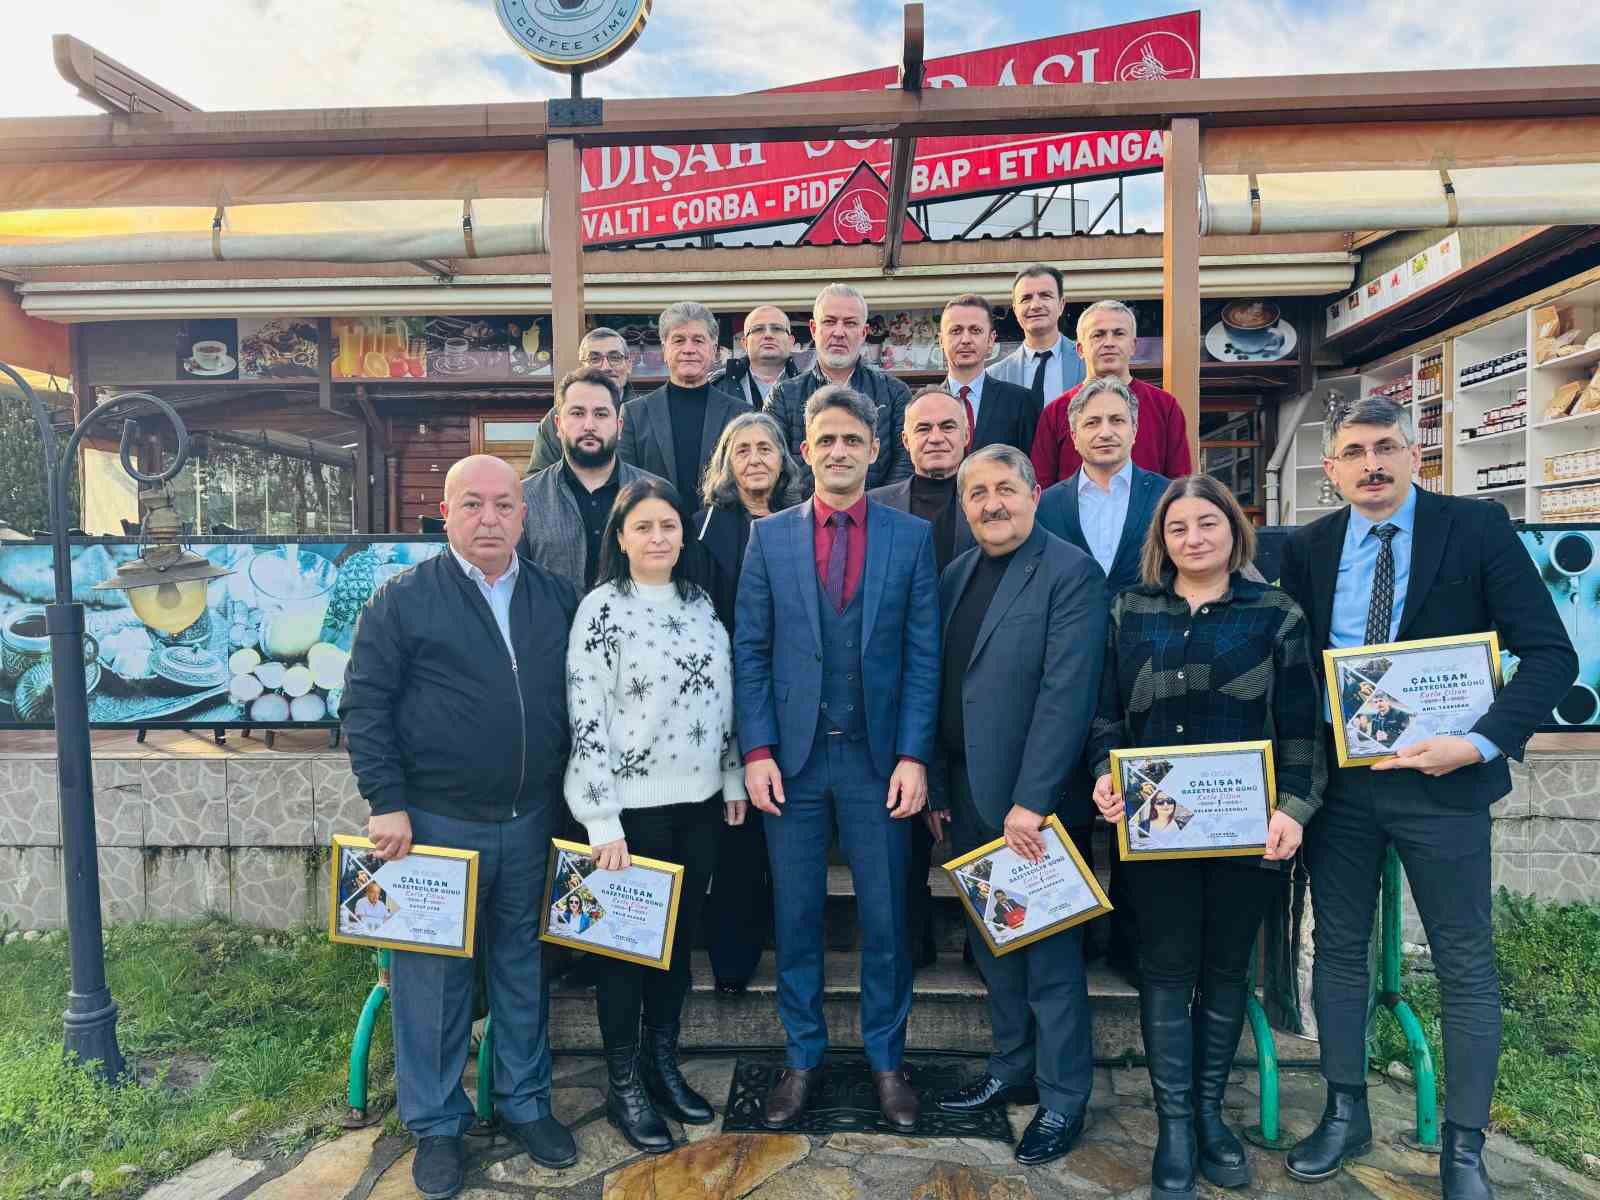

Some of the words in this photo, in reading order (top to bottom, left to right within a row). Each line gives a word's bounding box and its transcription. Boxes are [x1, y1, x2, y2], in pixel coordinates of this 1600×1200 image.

[516, 17, 583, 50] COFFEE
[592, 7, 628, 43] TIME
[673, 191, 759, 231] ÇORBA
[1000, 147, 1039, 181] ET
